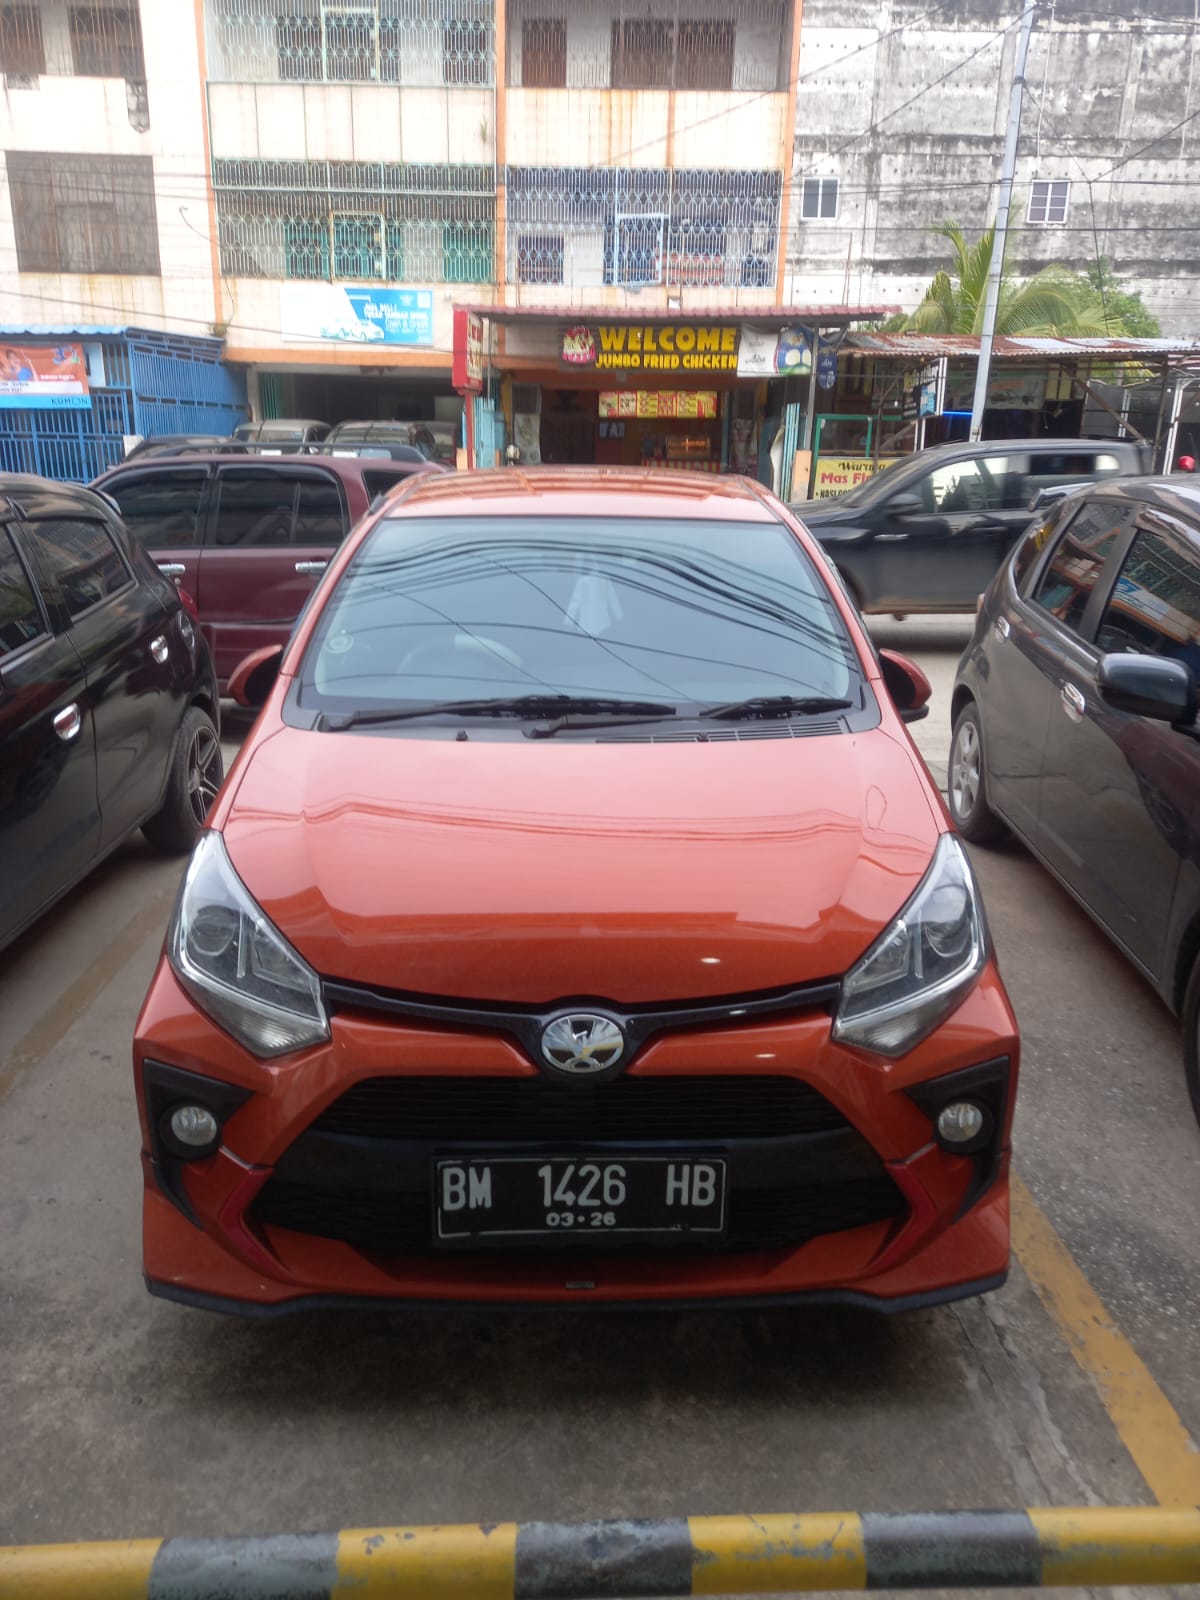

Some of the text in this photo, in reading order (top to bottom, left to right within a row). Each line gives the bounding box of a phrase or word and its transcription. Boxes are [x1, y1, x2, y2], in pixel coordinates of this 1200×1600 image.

[599, 326, 737, 352] WELCOME
[596, 353, 641, 369] JUMBO
[643, 353, 680, 369] FRIED
[682, 353, 738, 369] CHICKEN
[821, 472, 848, 484] Mas
[442, 1164, 716, 1211] BM 1426 HB
